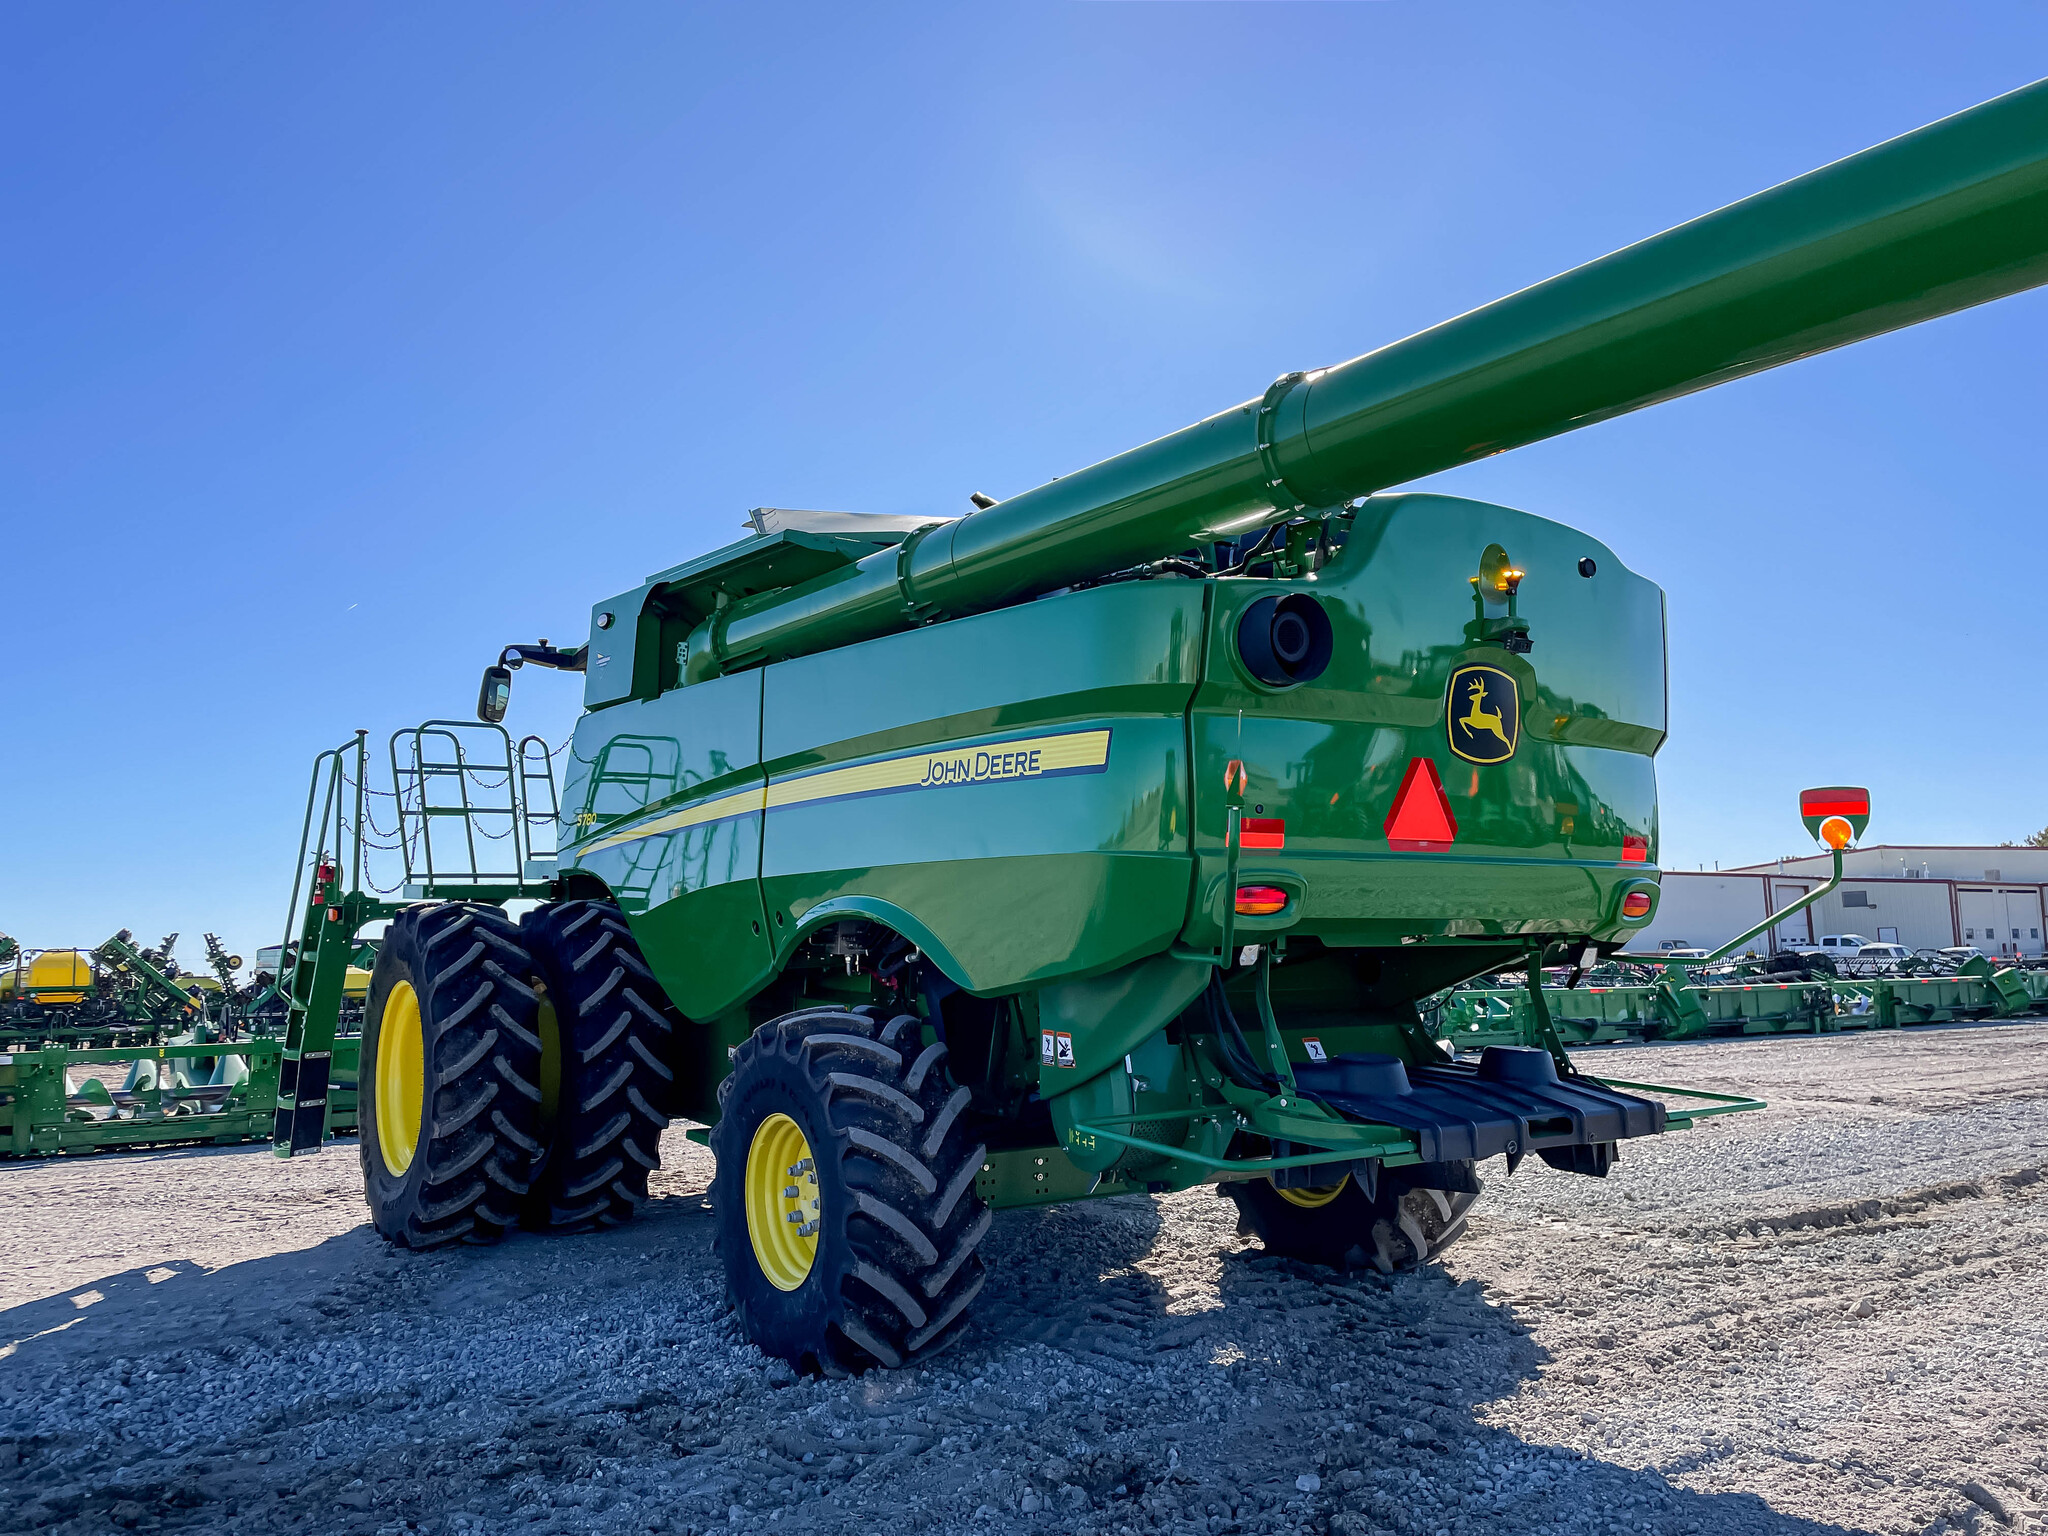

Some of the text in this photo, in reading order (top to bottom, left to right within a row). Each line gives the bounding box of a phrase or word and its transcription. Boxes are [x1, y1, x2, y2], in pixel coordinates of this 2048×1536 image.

[921, 750, 1042, 784] JOHN DEERE
[577, 812, 597, 827] S780
